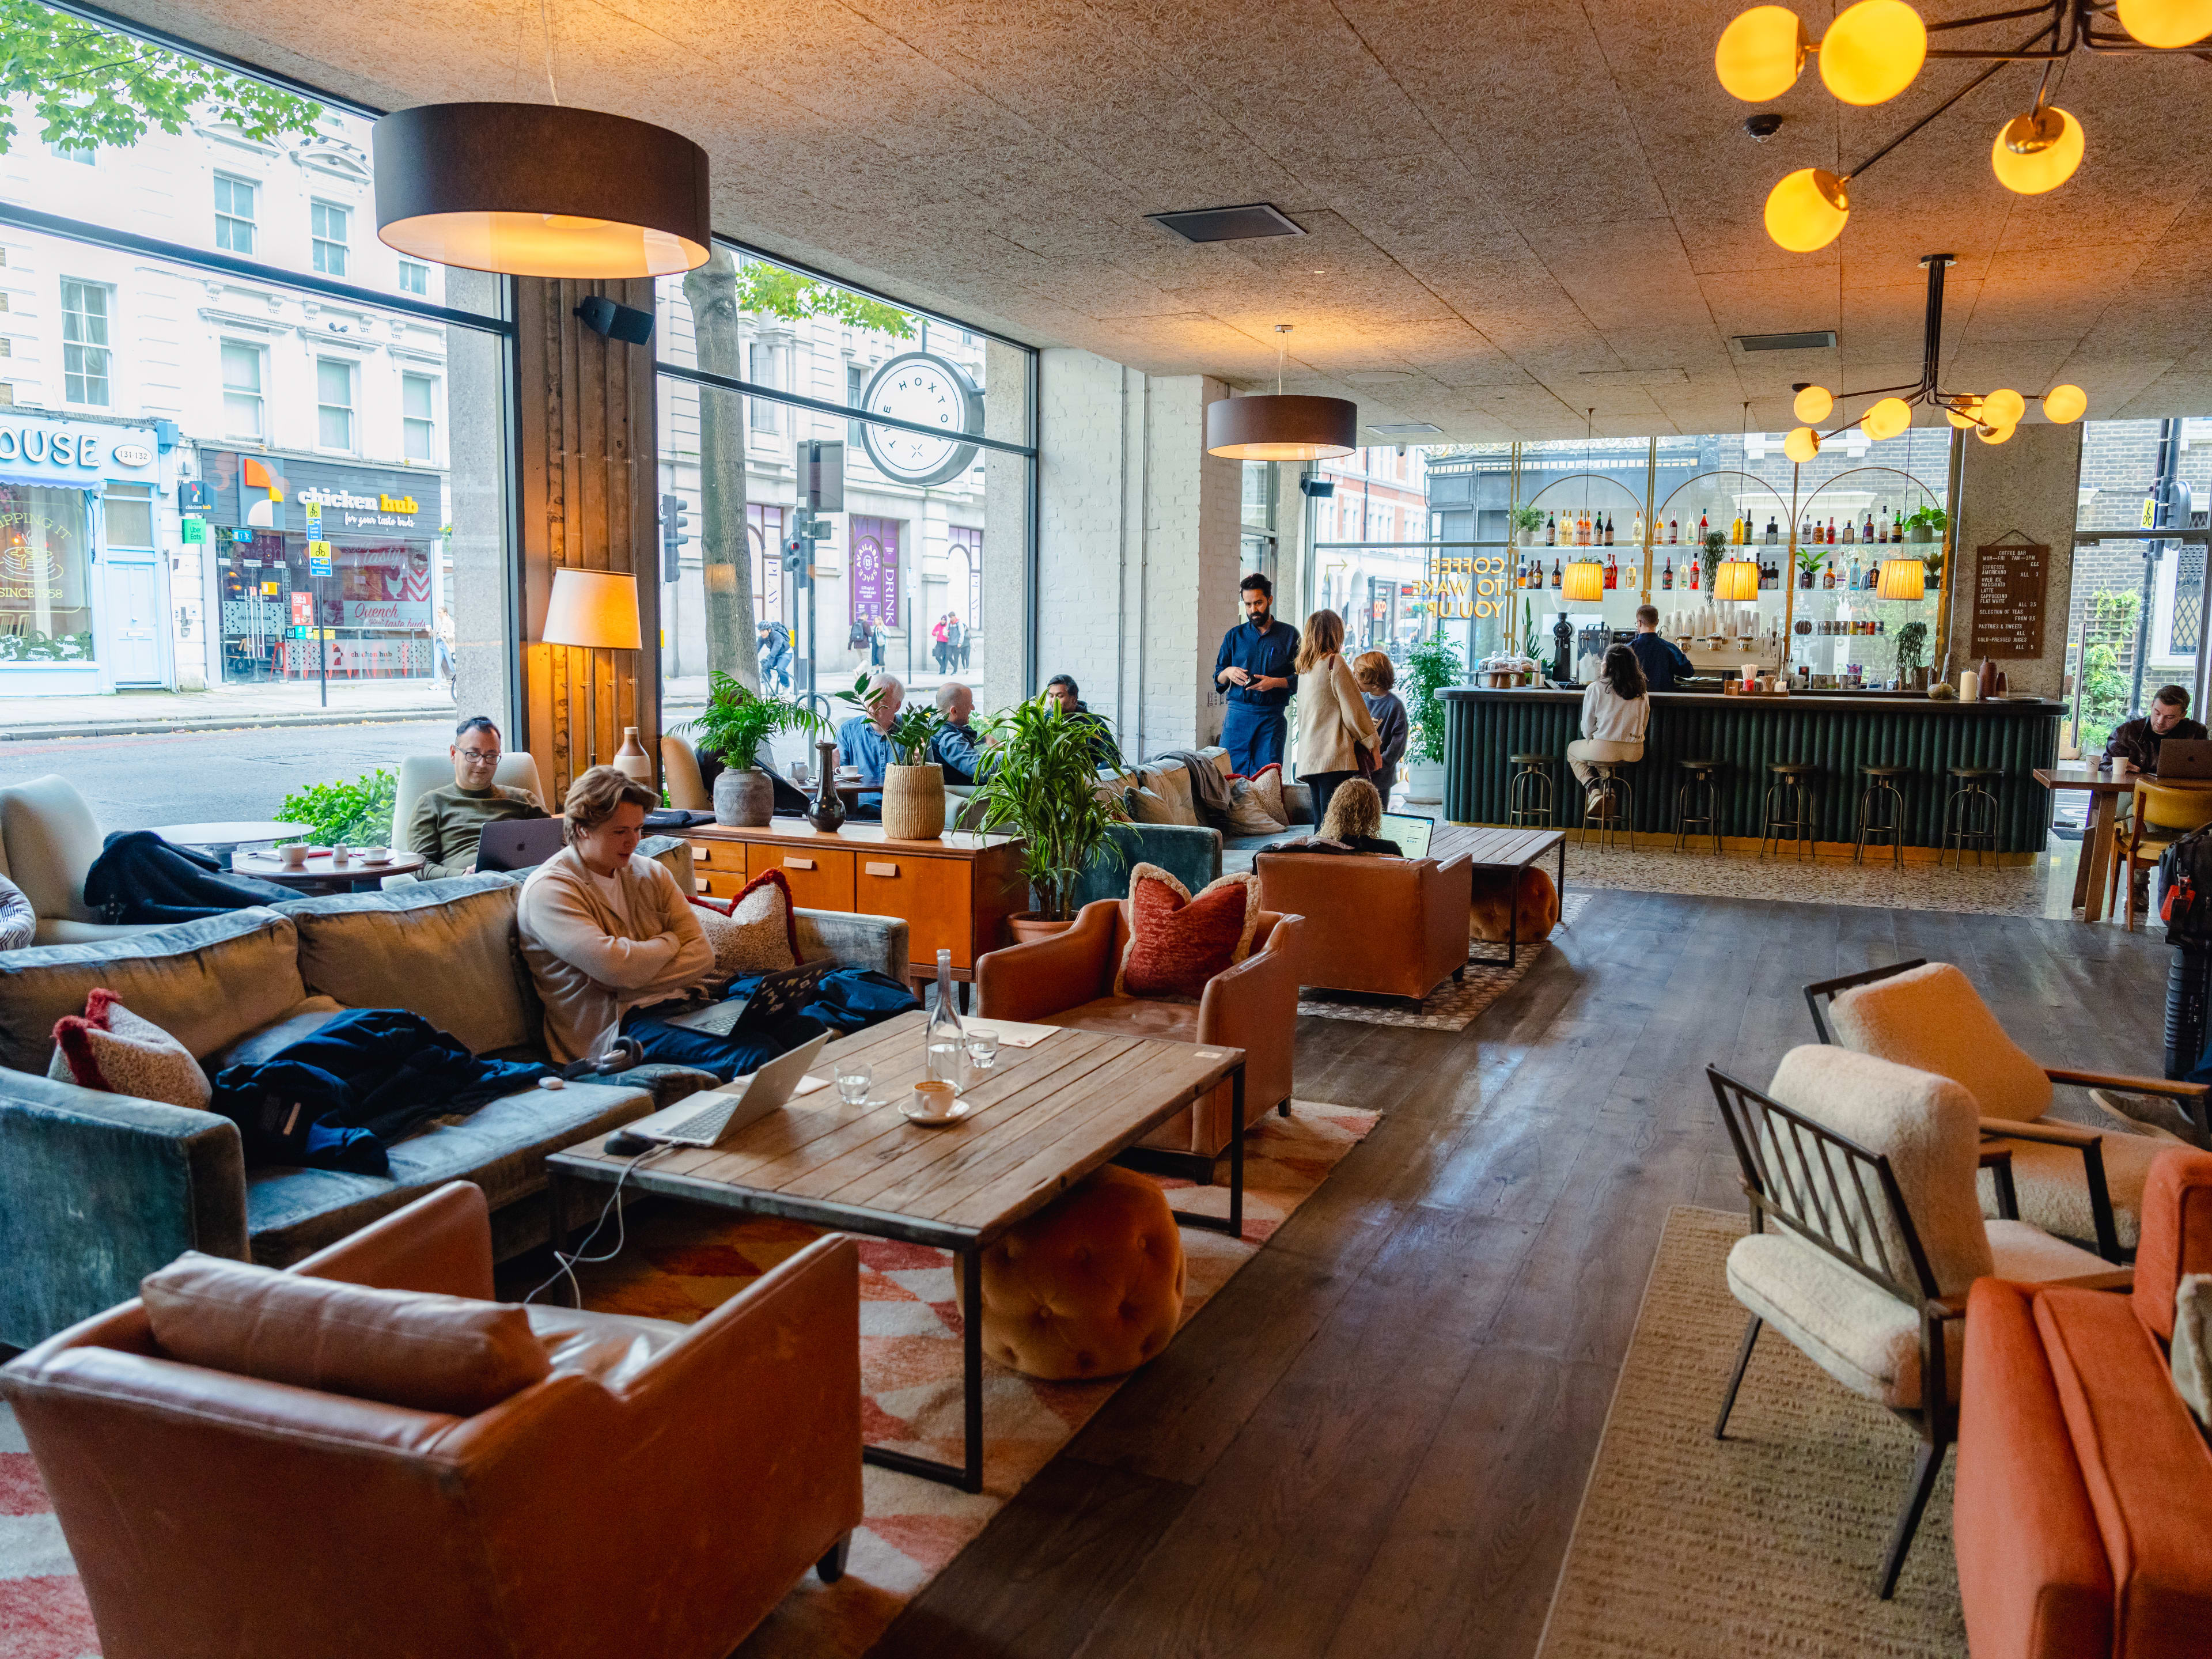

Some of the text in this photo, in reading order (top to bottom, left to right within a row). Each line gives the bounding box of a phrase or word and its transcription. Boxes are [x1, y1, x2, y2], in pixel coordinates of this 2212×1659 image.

[899, 377, 948, 441] HOXTO
[120, 450, 147, 460] 131-132
[297, 487, 419, 514] chicken hub
[344, 512, 415, 528] for your taste buds
[363, 546, 402, 570] tasty
[38, 589, 63, 599] 1958
[885, 569, 894, 624] DRINK
[355, 603, 399, 620] Quench
